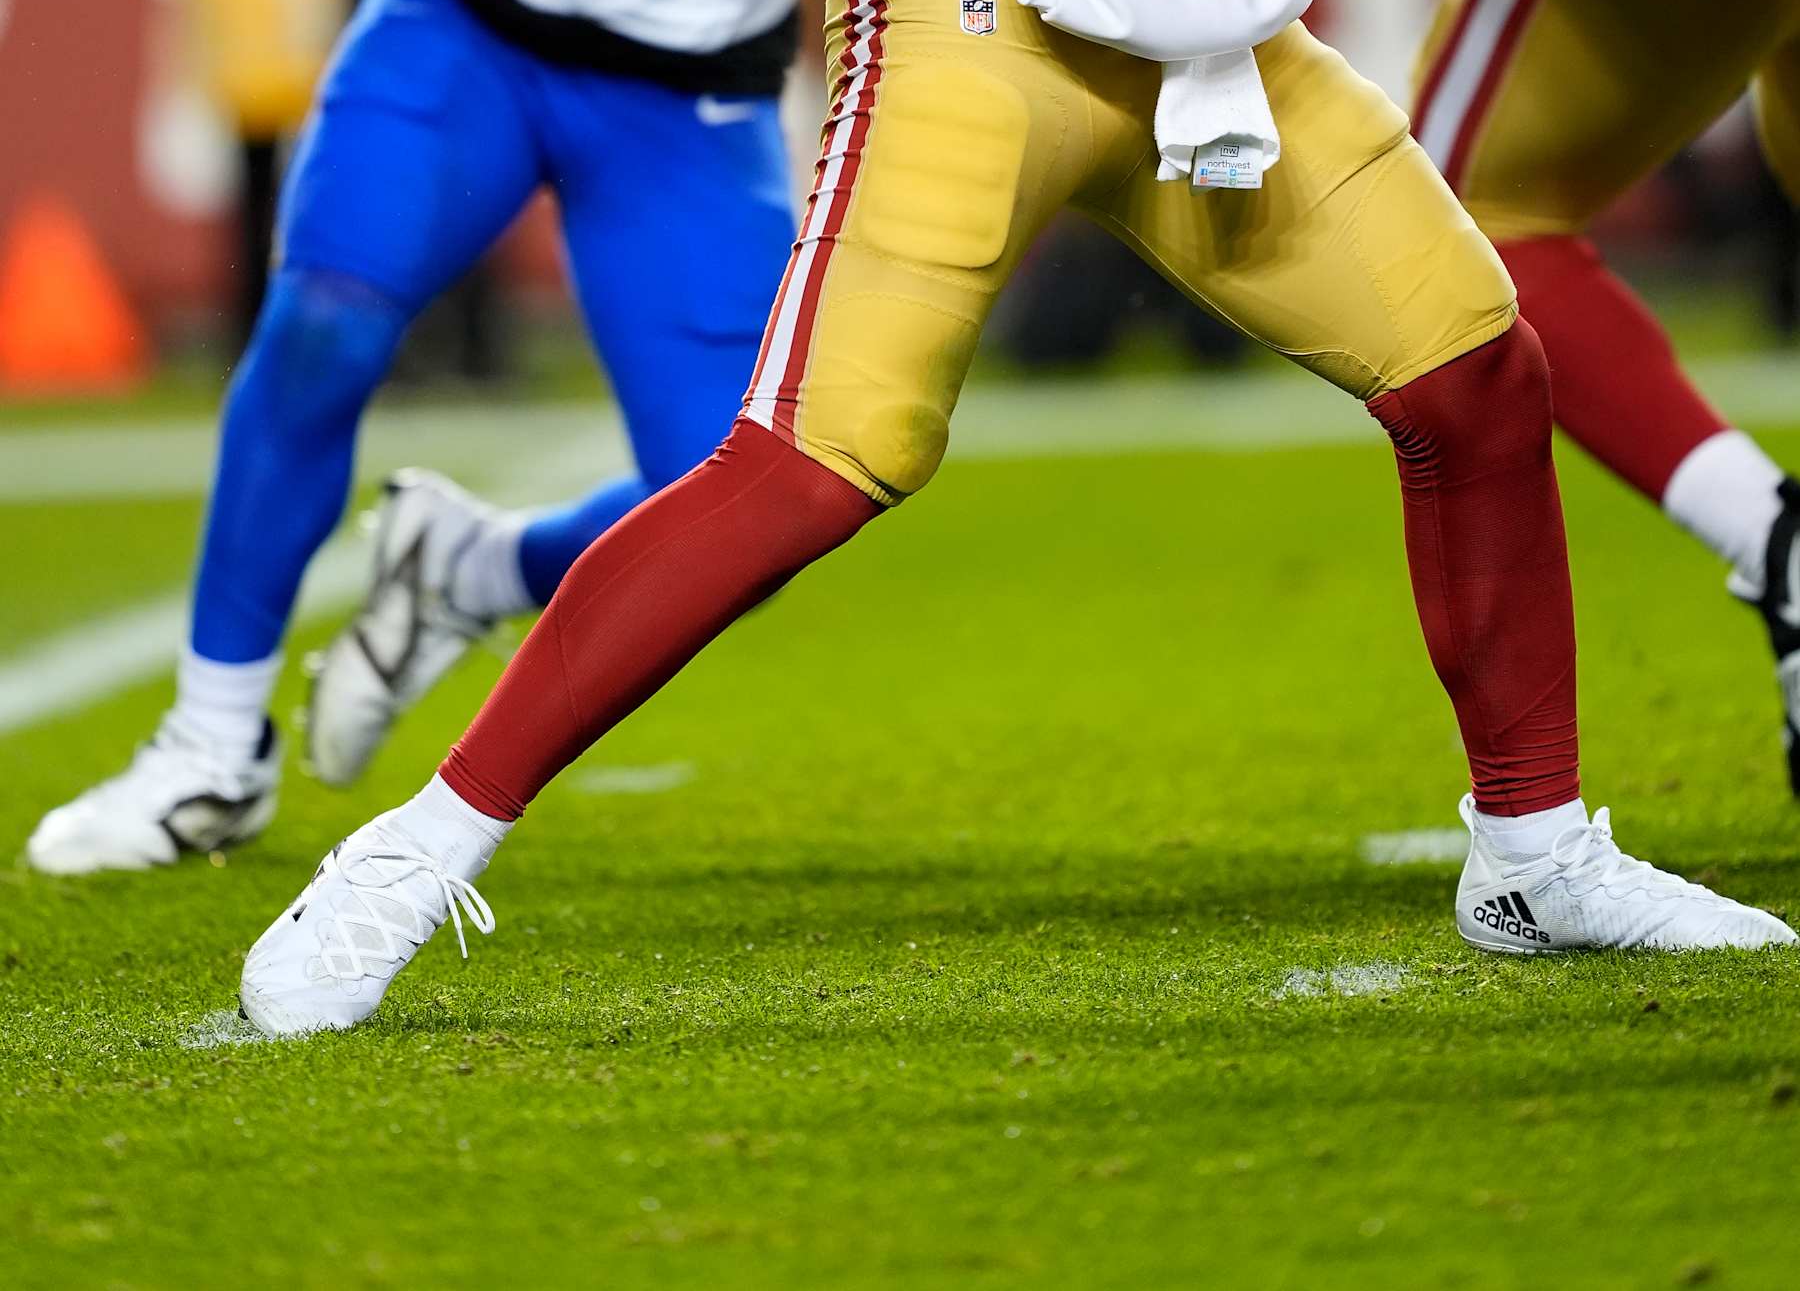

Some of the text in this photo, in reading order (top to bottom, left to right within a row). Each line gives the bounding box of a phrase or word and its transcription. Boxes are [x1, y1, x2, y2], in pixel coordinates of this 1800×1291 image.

[965, 11, 992, 30] NFL
[1207, 160, 1251, 170] northwest
[1473, 902, 1552, 945] adidas
